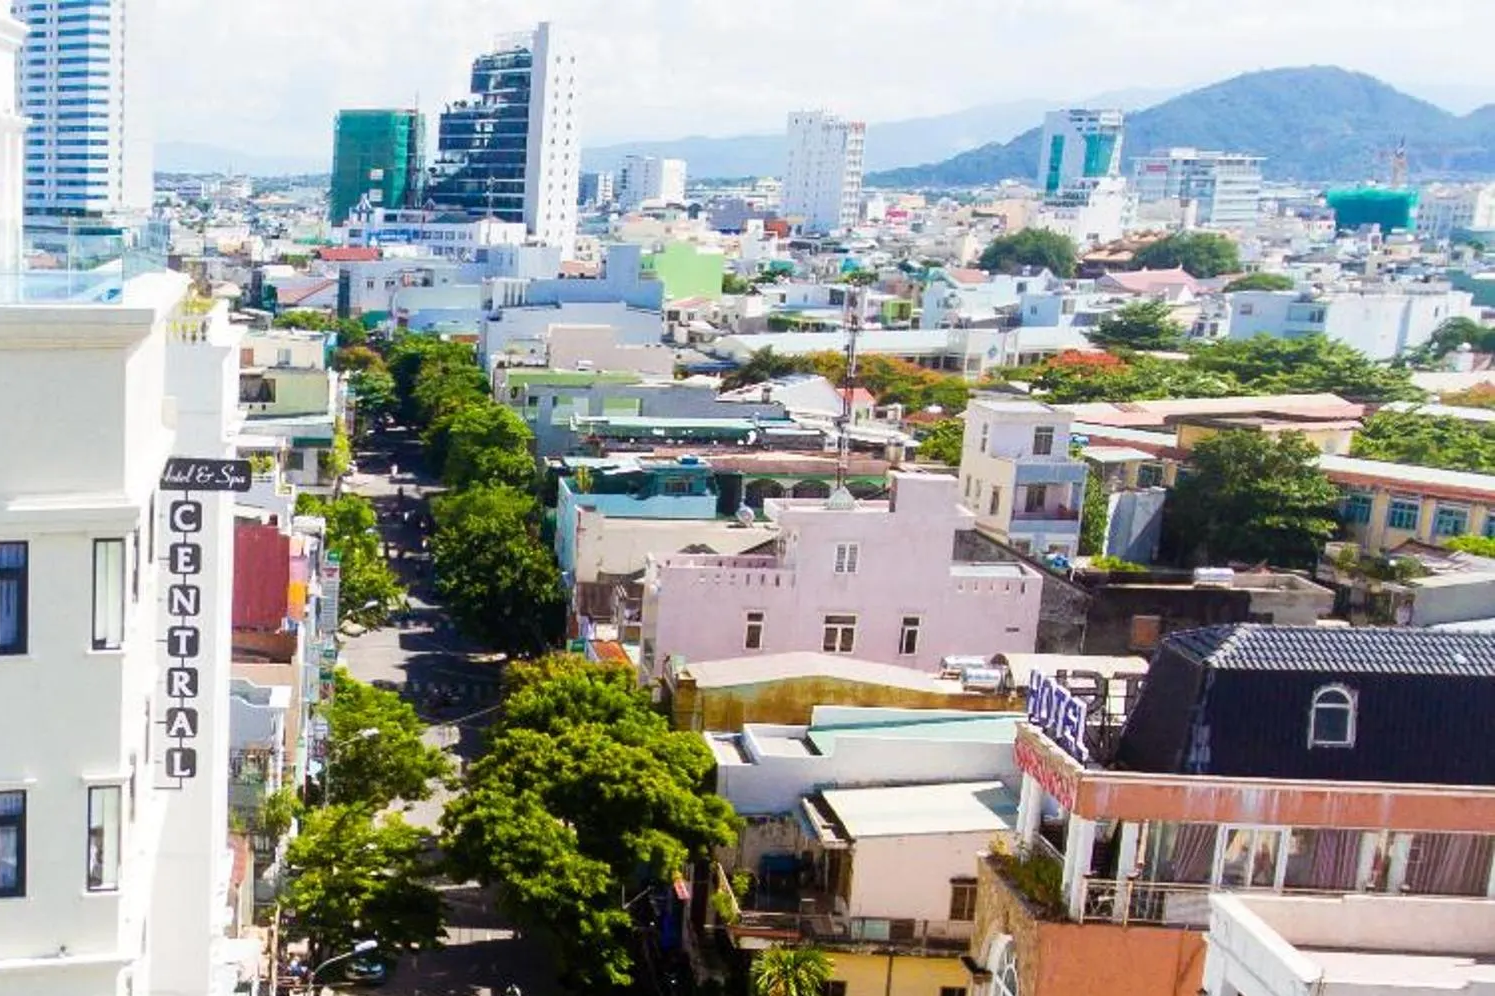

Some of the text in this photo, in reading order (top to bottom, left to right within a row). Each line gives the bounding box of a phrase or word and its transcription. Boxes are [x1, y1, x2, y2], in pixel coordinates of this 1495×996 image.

[215, 464, 246, 488] Spa
[170, 506, 198, 777] CENTRAL
[1027, 669, 1089, 762] HOTEL
